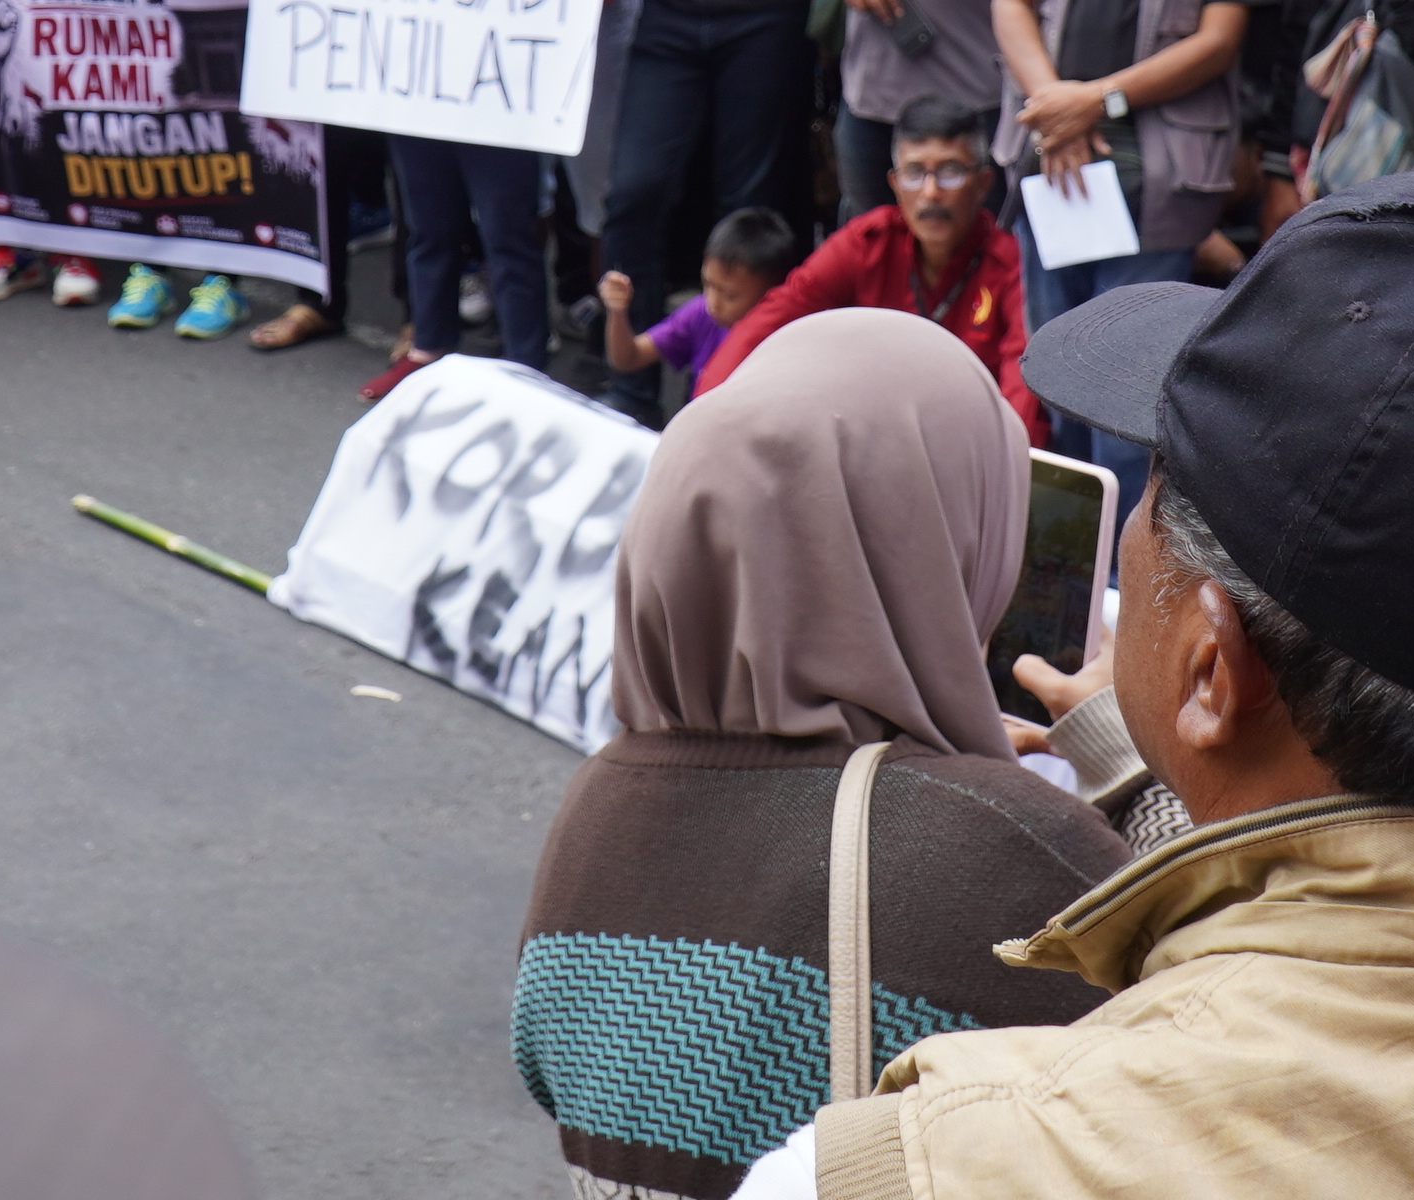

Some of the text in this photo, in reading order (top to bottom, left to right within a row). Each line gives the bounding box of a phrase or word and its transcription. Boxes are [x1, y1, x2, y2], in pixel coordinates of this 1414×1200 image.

[32, 16, 173, 59] RUMAH
[56, 110, 229, 155] JANGAN
[63, 152, 256, 200] DITUTUP!
